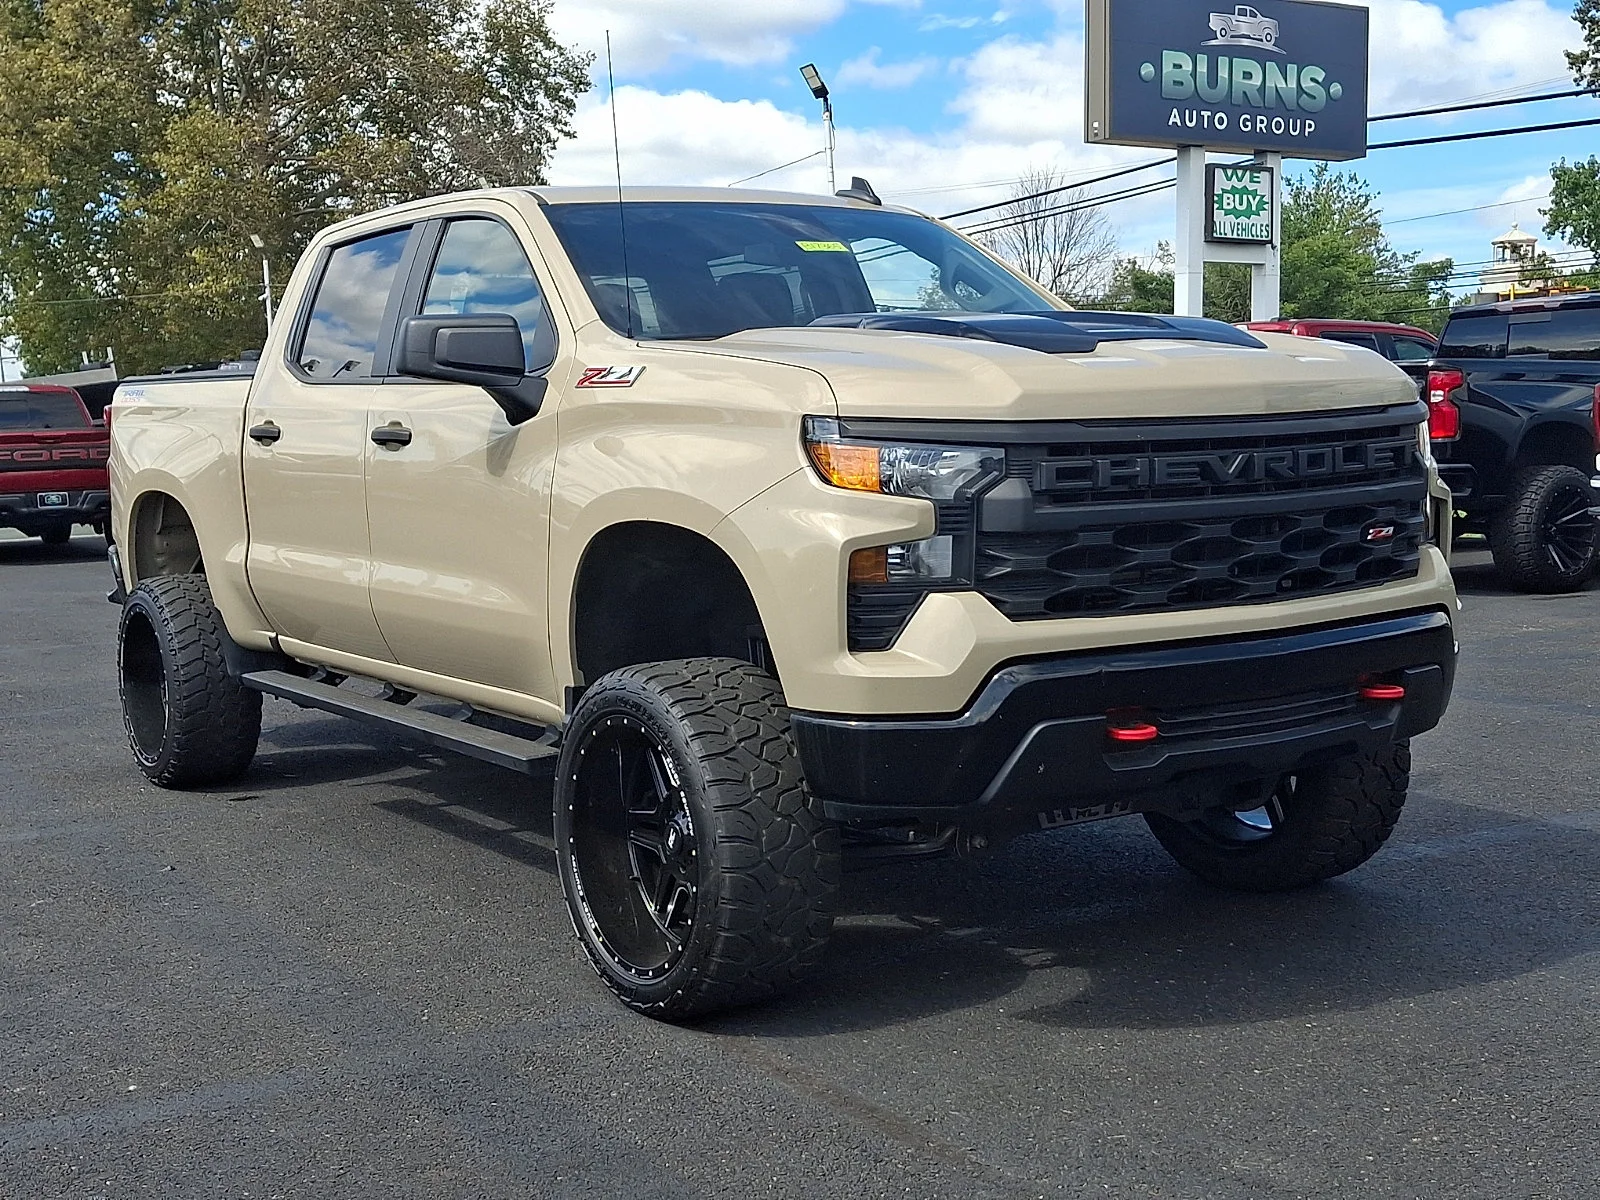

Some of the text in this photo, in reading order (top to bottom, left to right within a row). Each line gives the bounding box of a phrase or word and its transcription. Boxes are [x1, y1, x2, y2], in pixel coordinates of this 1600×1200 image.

[1161, 50, 1327, 113] BURNS
[1168, 107, 1316, 136] AUTO GROUP
[1222, 168, 1261, 183] WE
[1222, 193, 1260, 211] BUY
[1213, 221, 1269, 239] ALL VEHICLES
